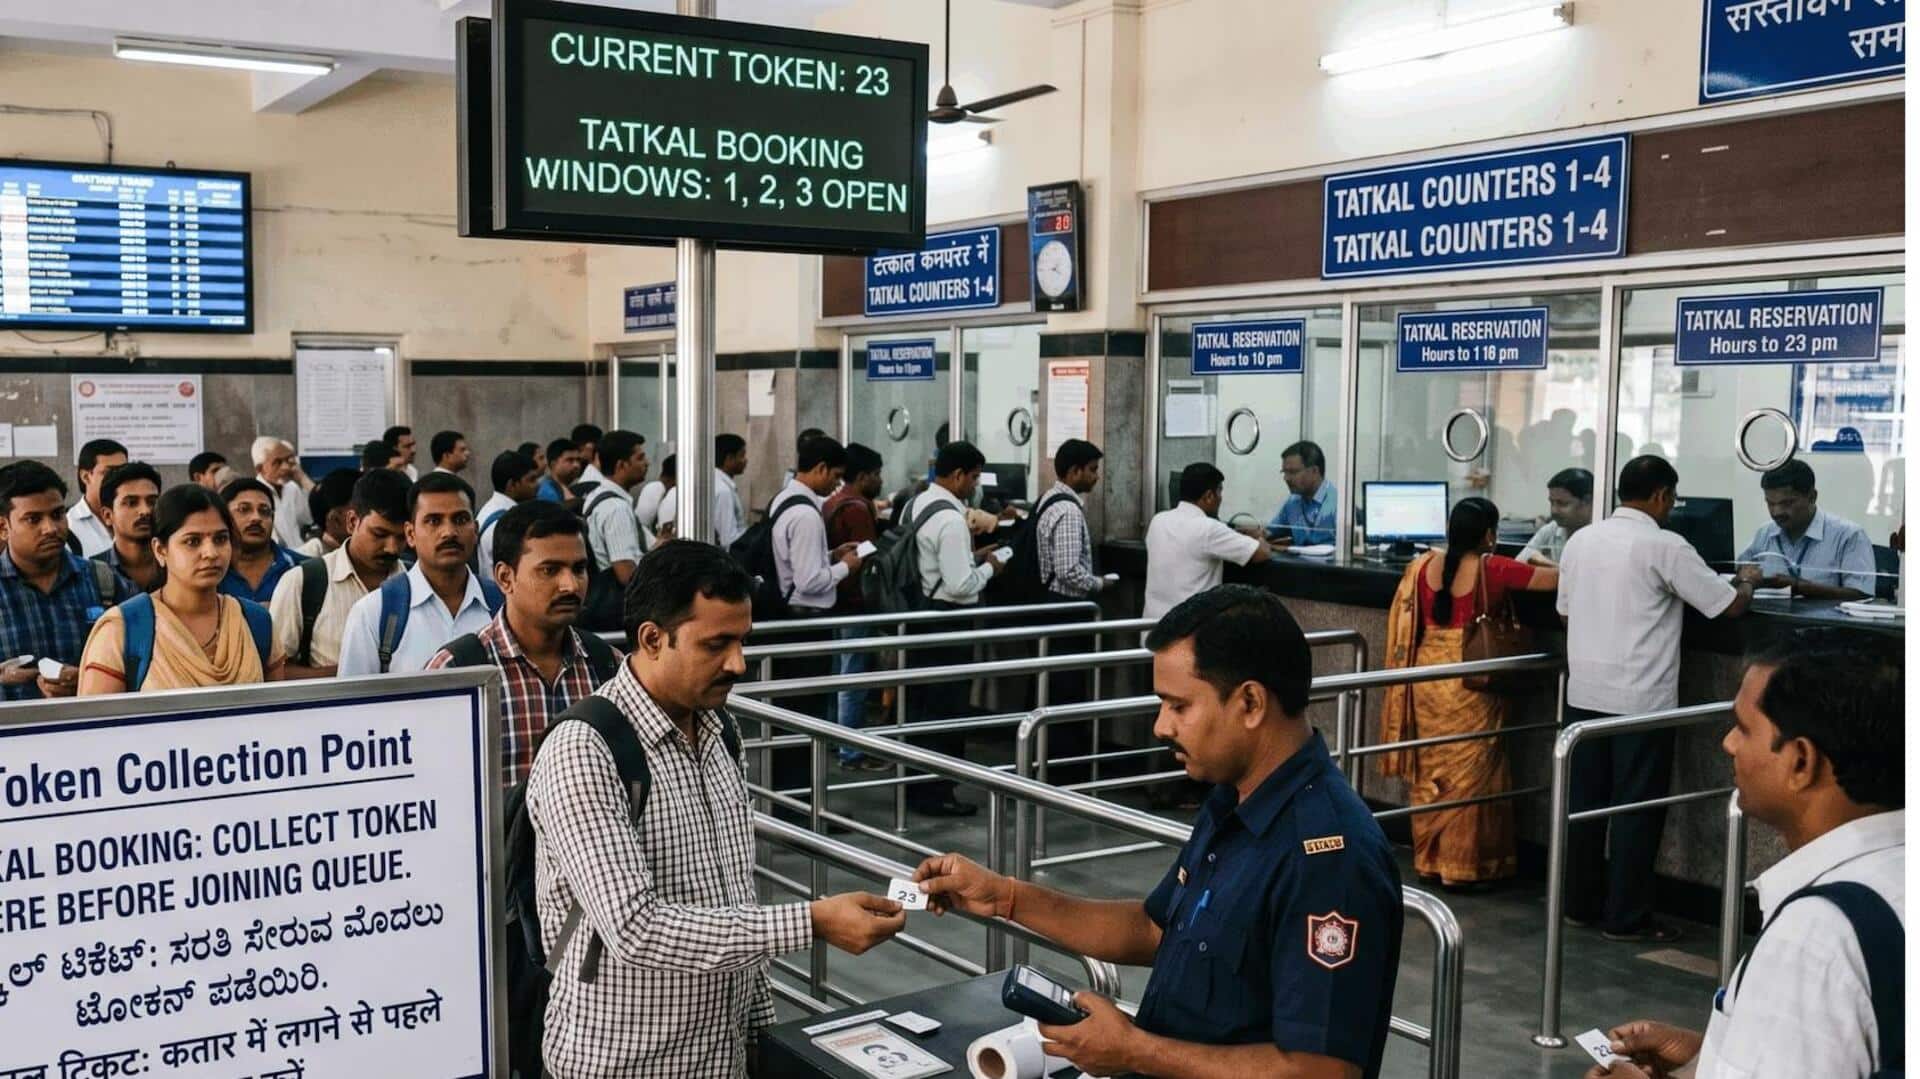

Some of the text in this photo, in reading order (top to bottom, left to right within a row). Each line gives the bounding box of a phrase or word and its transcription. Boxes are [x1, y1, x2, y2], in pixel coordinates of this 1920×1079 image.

[551, 32, 890, 96] CURRENT TOKEN: 23
[579, 118, 864, 170] TATKAL BOOKING
[525, 156, 907, 213] WINDOWS: 1, 2, 3 OPEN
[1334, 155, 1612, 219] TATKAL COUNTERS 1-4
[1333, 208, 1609, 264] TATKAL COUNTERS 1-4
[868, 275, 994, 306] TATKAL COUNTERS 1-4
[1404, 319, 1542, 342] TATKAL RESERVATION
[1685, 302, 1873, 331] TATKAL RESERVATION
[1197, 329, 1300, 350] TATKAL RESERVATION
[1210, 351, 1283, 368] Hours to 10 pm
[1422, 347, 1456, 362] Hours
[1457, 346, 1471, 361] to
[1498, 347, 1519, 364] pm
[1710, 334, 1838, 356] Hours to 23 pm
[0, 728, 412, 807] oken Collection Point
[0, 800, 437, 883] AL BOOKING: COLLECT TOKEN
[57, 880, 176, 926] BEFORE
[184, 863, 302, 909] JOINING
[312, 850, 412, 892] QUEUE.
[898, 890, 918, 904] 23
[169, 927, 233, 965] ಸರತಿ
[159, 1032, 238, 1068] कतार
[245, 1018, 268, 1052] में
[275, 1006, 341, 1048] लगने
[349, 1000, 375, 1035] से
[382, 988, 444, 1029] पहले
